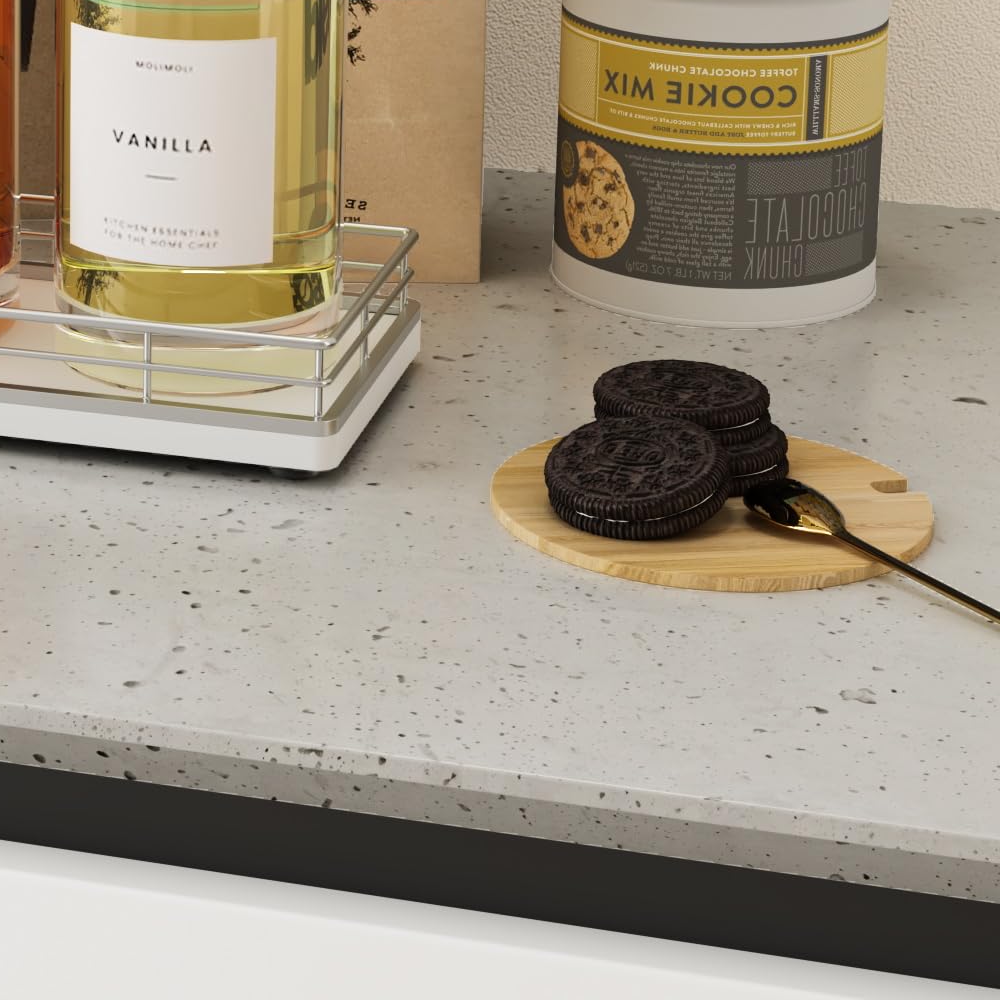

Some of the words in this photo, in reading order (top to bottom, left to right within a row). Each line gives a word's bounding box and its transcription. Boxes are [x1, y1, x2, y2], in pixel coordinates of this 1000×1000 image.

[135, 61, 193, 73] MOLIMOLI
[113, 129, 212, 154] VANILLA
[104, 217, 148, 232] KITCHEN
[152, 226, 219, 237] ESSENTIALS
[104, 228, 123, 240] FOR
[128, 234, 146, 245] THE
[150, 239, 183, 249] HOME
[187, 241, 218, 250] CHEF
